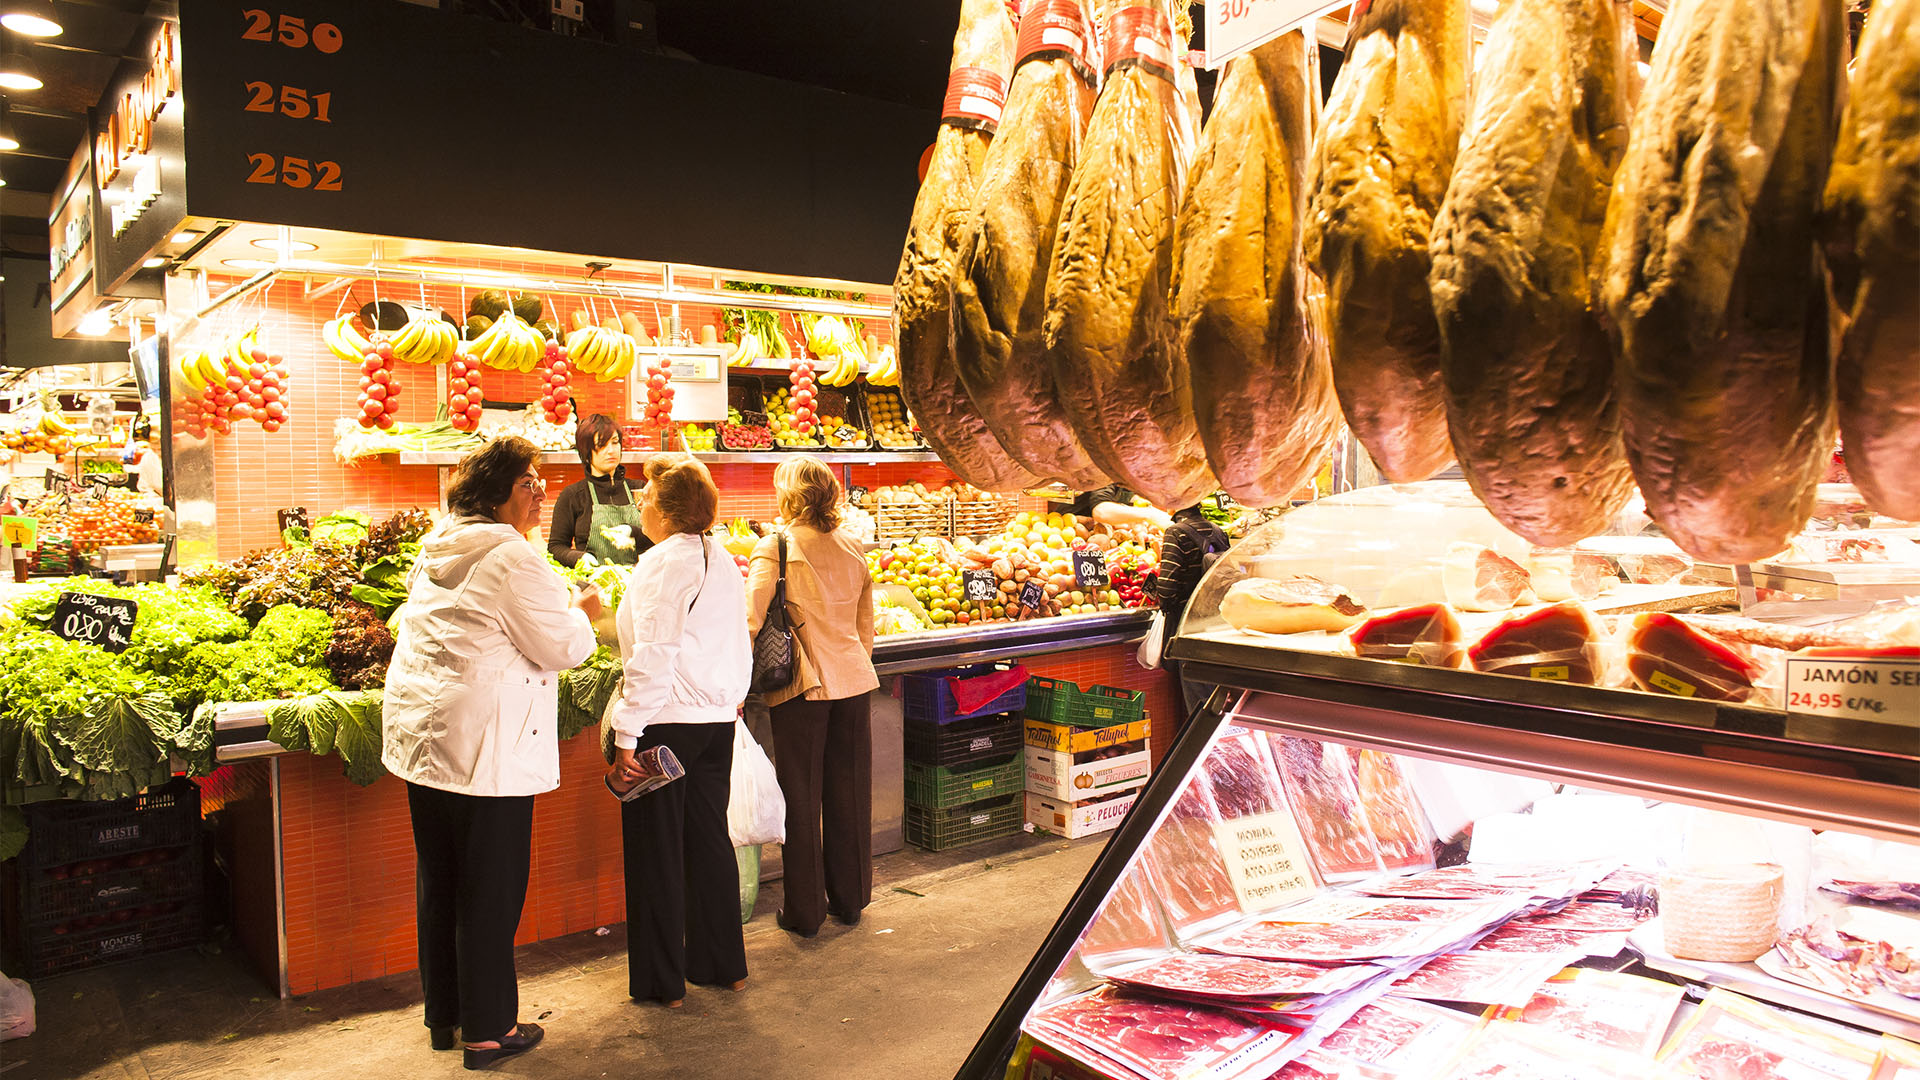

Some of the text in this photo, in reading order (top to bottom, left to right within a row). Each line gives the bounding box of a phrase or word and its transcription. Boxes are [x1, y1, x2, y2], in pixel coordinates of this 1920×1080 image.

[241, 9, 343, 54] 250
[244, 80, 332, 123] 251
[246, 152, 343, 191] 252
[1803, 666, 1879, 684] JAMÓN
[1790, 692, 1842, 709] 24,95
[1105, 768, 1142, 783] FIGUERES
[98, 825, 140, 841] ARESTE
